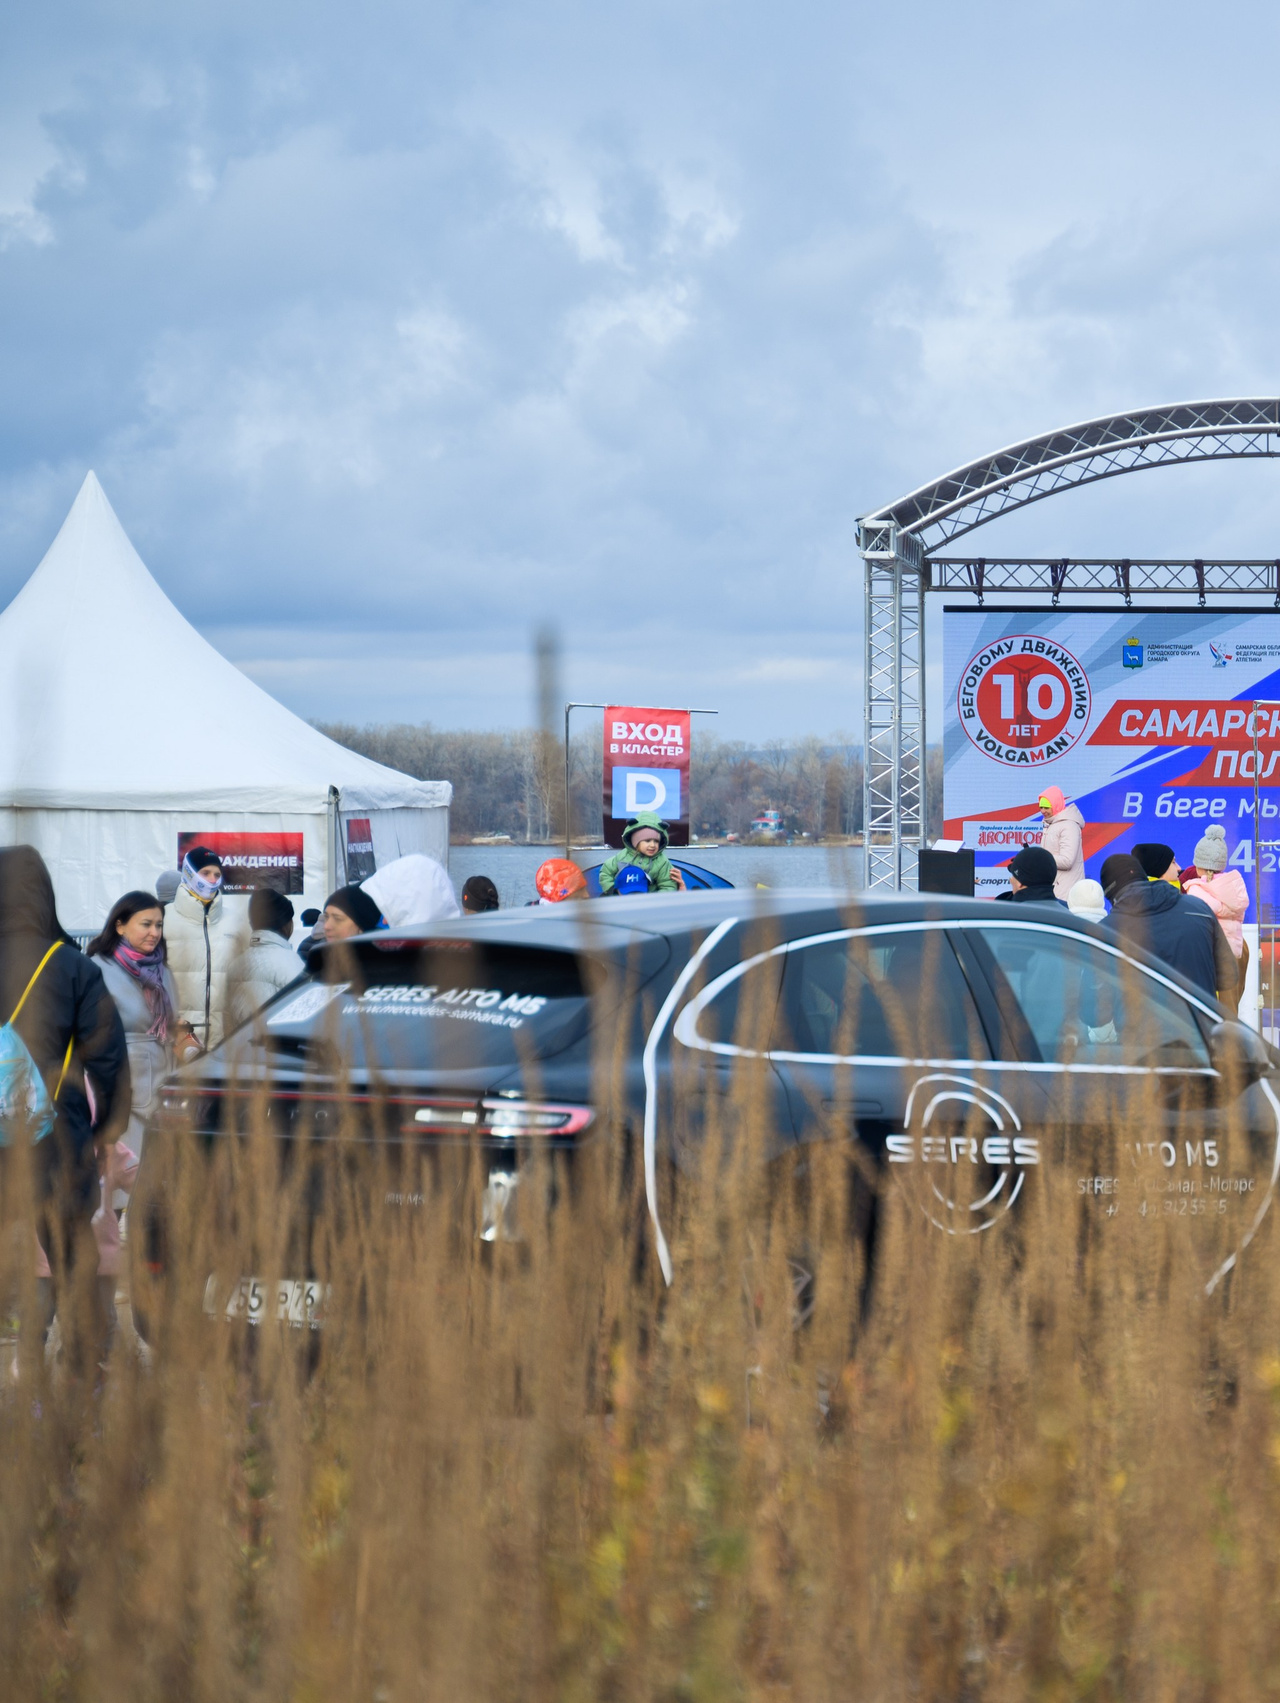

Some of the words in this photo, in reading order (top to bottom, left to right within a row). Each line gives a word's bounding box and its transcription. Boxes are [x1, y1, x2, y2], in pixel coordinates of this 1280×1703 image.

[962, 640, 1014, 719] БЕГОВОМУ
[1021, 639, 1088, 720] ДВИЖЕНИЮ
[992, 673, 1066, 721] 10
[612, 722, 683, 745] ВХОД
[975, 728, 1069, 763] VOLGAMAN
[1008, 724, 1041, 737] ЛЕТ
[610, 743, 619, 753] В
[622, 744, 684, 756] КЛАСТЕР
[625, 773, 666, 812] D
[1122, 791, 1144, 818] В
[1154, 790, 1228, 818] беге
[978, 831, 1043, 846] ДВОРЦОВ
[220, 856, 298, 868] АЖДЕНИЕ
[1228, 839, 1256, 873] 4
[358, 985, 438, 1002] SERES
[498, 993, 547, 1015] M5
[885, 1134, 1040, 1164] SERES
